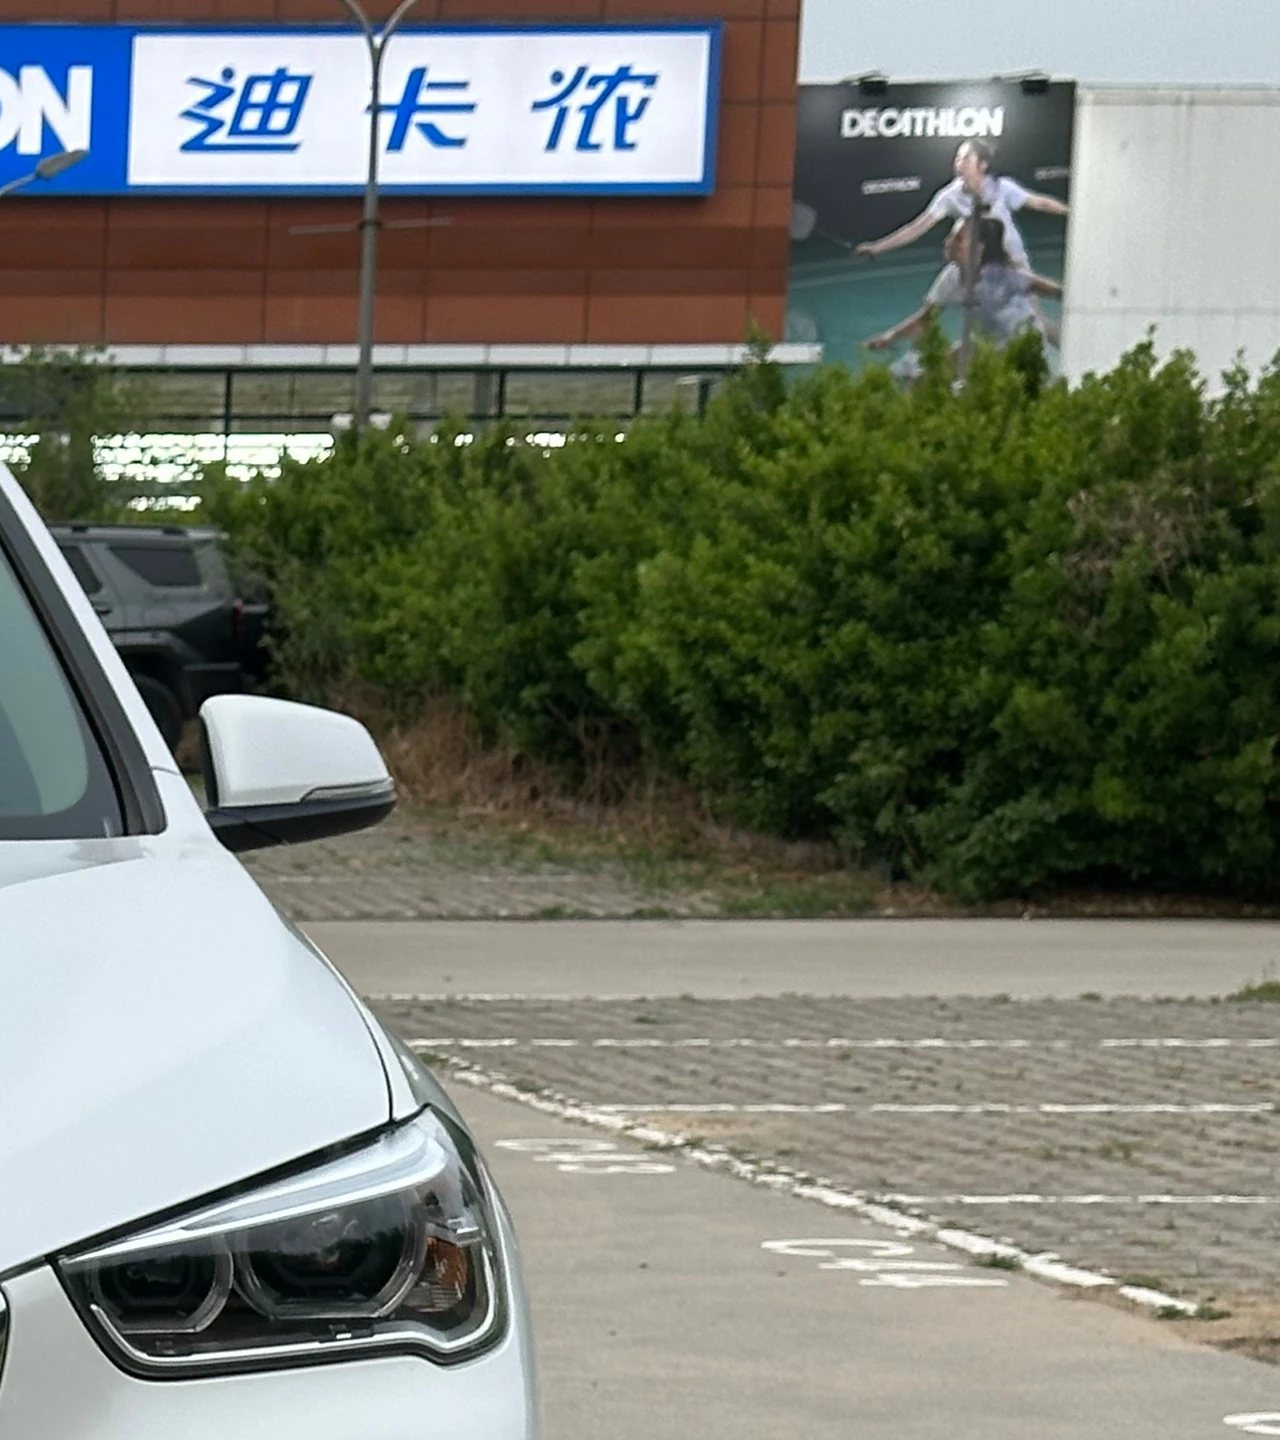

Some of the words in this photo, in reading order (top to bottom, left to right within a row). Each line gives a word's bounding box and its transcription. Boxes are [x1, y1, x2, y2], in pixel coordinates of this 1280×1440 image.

[178, 64, 659, 153] 迪卡侬
[841, 105, 1005, 138] DECATHLON
